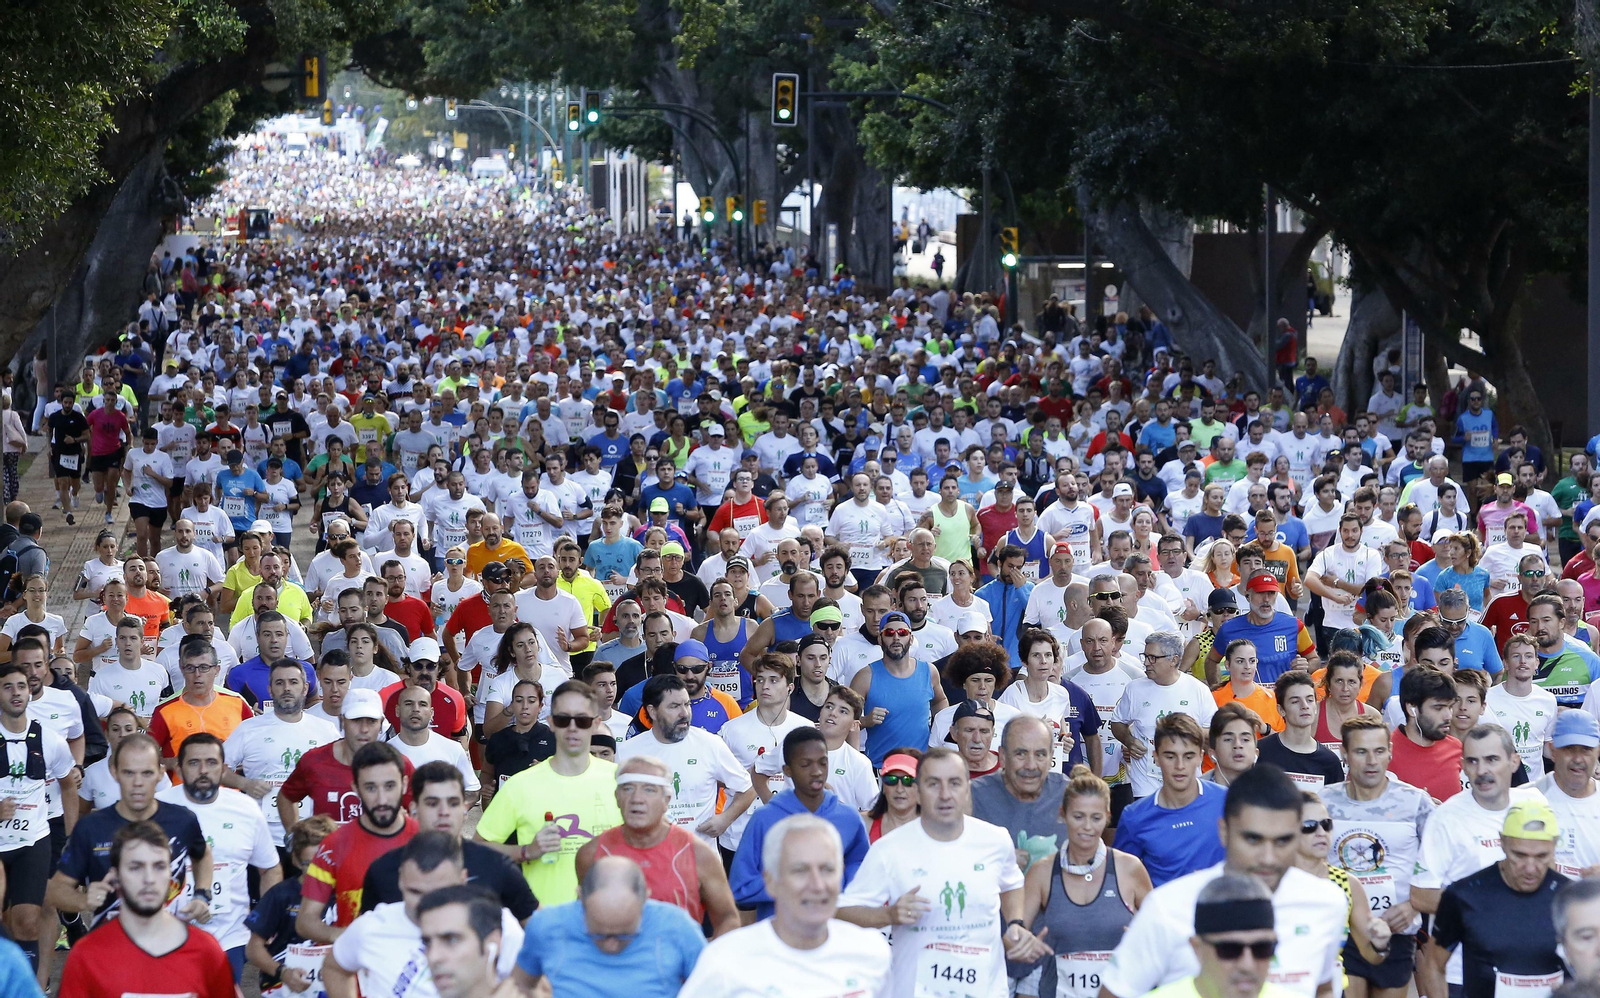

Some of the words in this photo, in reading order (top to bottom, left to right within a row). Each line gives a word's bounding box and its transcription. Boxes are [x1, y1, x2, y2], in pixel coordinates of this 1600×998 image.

[226, 502, 242, 511] 1279
[195, 528, 211, 536] 1016
[738, 523, 756, 532] 3535
[446, 534, 466, 543] 17278
[521, 530, 543, 538] 17279
[1178, 621, 1189, 631] 71
[1274, 637, 1288, 652] 091
[1369, 895, 1392, 911] 23
[930, 963, 977, 984] 1448
